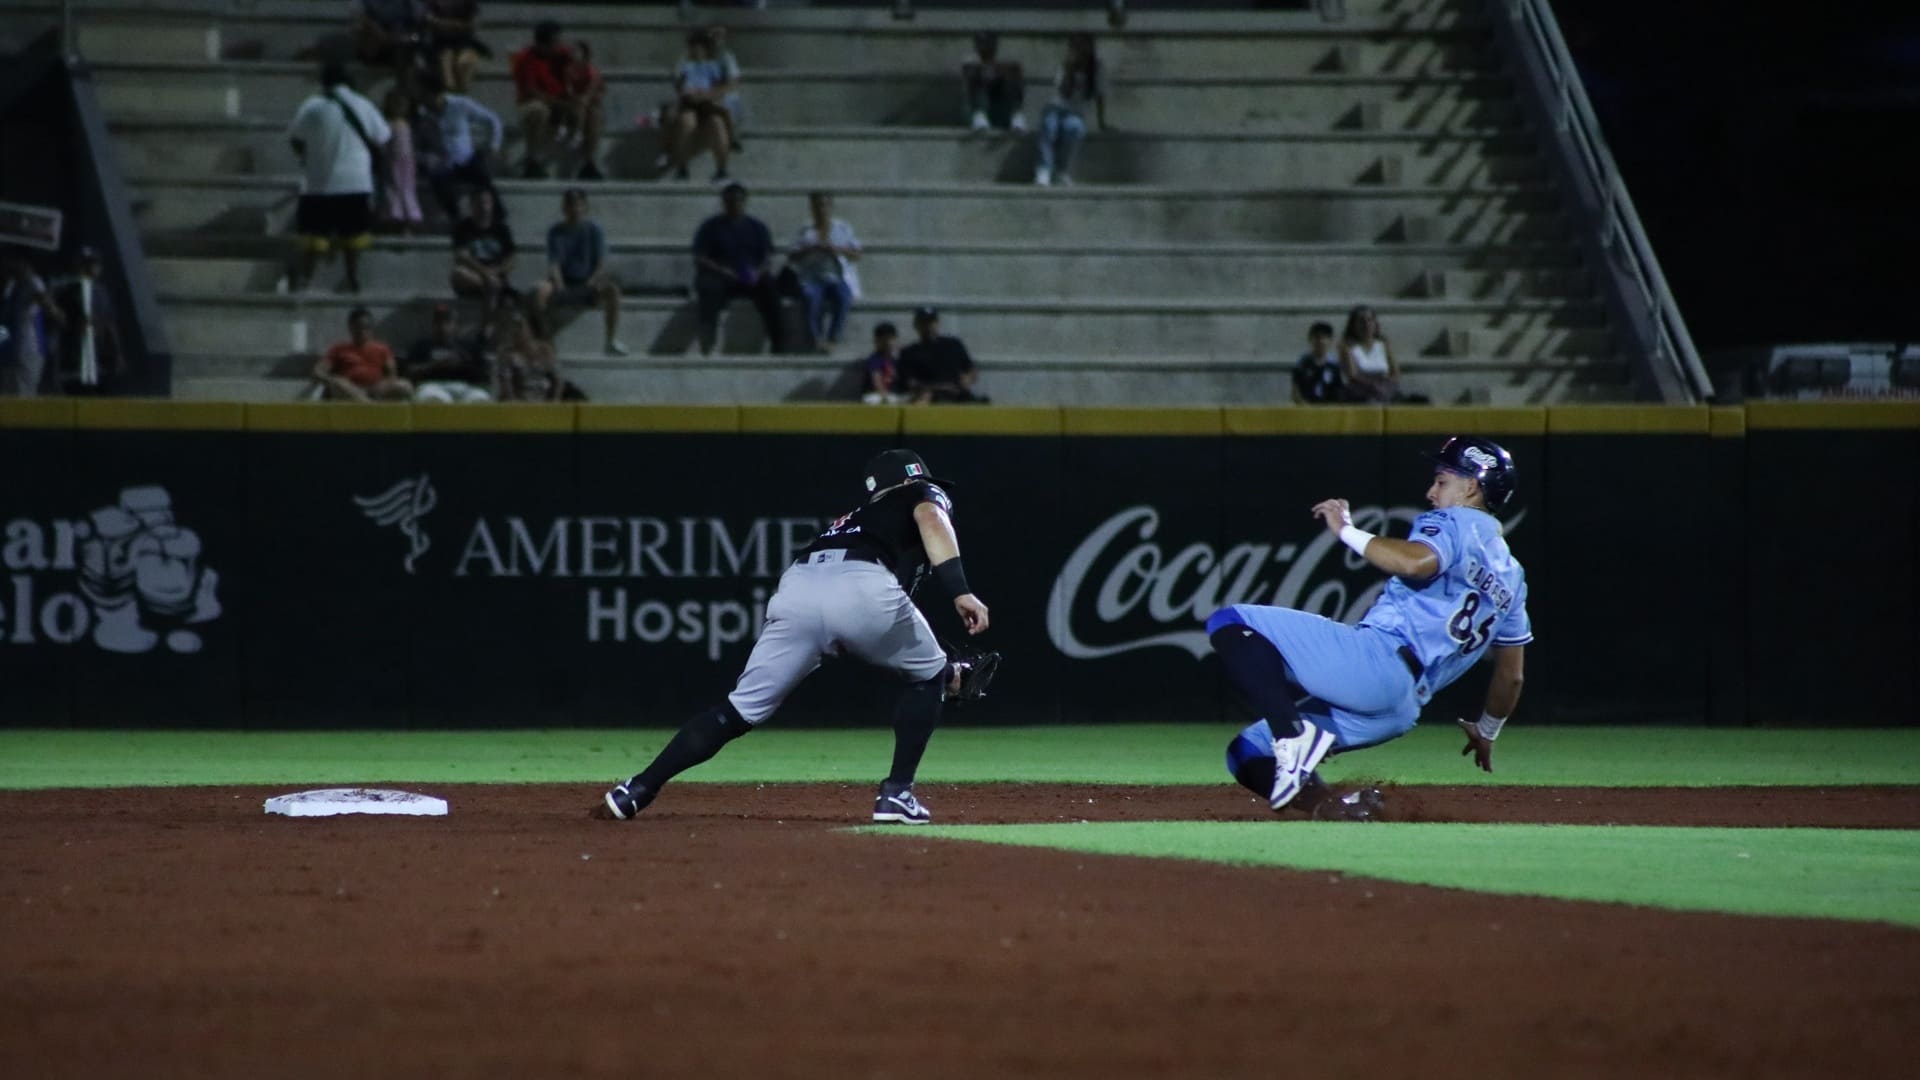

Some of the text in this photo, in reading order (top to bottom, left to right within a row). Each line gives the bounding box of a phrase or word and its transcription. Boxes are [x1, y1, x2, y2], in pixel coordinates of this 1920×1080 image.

[456, 516, 832, 577] AMERIME
[0, 575, 89, 642] lo
[588, 586, 778, 661] Hospi
